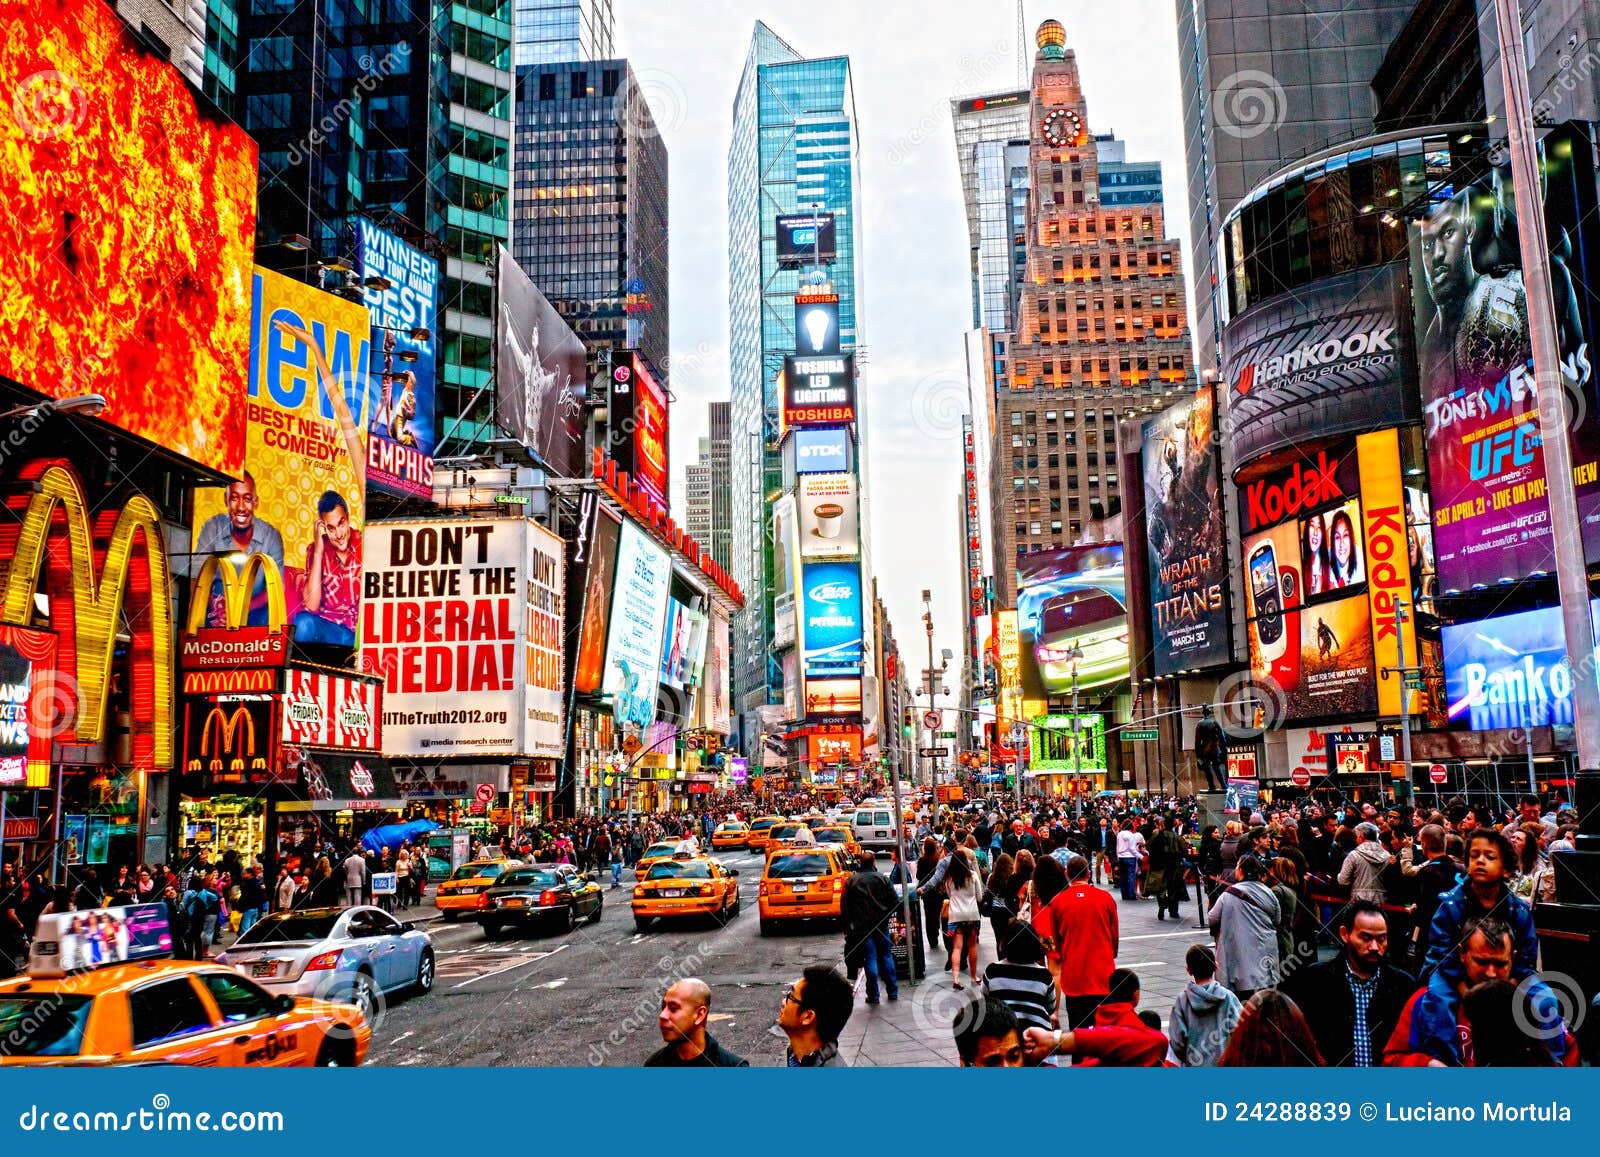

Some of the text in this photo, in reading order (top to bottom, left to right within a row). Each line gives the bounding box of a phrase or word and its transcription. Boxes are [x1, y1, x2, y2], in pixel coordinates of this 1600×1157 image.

[361, 220, 436, 284] WINNER!
[364, 247, 433, 298] 2010 TONY AWARD
[363, 265, 433, 330] BEST
[795, 294, 838, 304] TOSHIBA
[801, 284, 831, 295] 2012
[364, 301, 432, 354] MUSICAL
[794, 359, 846, 375] TOSHIBA
[810, 374, 830, 388] LED
[1271, 354, 1394, 391] driving emotion
[614, 384, 630, 393] LG
[794, 388, 847, 404] LIGHTING
[1425, 386, 1487, 440] JONES
[1484, 374, 1513, 415] VS
[248, 403, 338, 444] BEST NEW
[786, 407, 854, 421] TOSHIBA
[369, 435, 434, 487] EMPHIS
[810, 445, 843, 457] TDK
[1470, 422, 1536, 482] UFC
[1247, 450, 1343, 529] Kodak
[1435, 504, 1450, 528] SAT
[1451, 499, 1476, 523] APRIL
[1476, 496, 1486, 515] 21
[1492, 487, 1512, 511] LIVE
[1512, 485, 1526, 504] ON
[389, 525, 494, 568] DON'T
[364, 566, 516, 599] BELIEVE THE
[533, 547, 557, 589] DON'T
[1160, 553, 1211, 584] WRATH
[1366, 505, 1410, 642] Kodak
[362, 598, 516, 644] LIBERAL
[550, 592, 561, 617] THE
[1154, 584, 1222, 630] TITANS
[183, 639, 282, 654] McDonald's
[526, 606, 561, 652] LIBERAL
[1172, 631, 1206, 647] MARCH 30
[199, 654, 264, 665] Restaurant
[362, 643, 516, 694] MEDIA!
[526, 645, 561, 692] MEDIA!
[1336, 670, 1346, 678] WAY
[1347, 669, 1356, 677] YOU
[1465, 655, 1549, 707] Bank
[383, 708, 508, 726] llTheTruth2012.org
[430, 737, 514, 747] media research center
